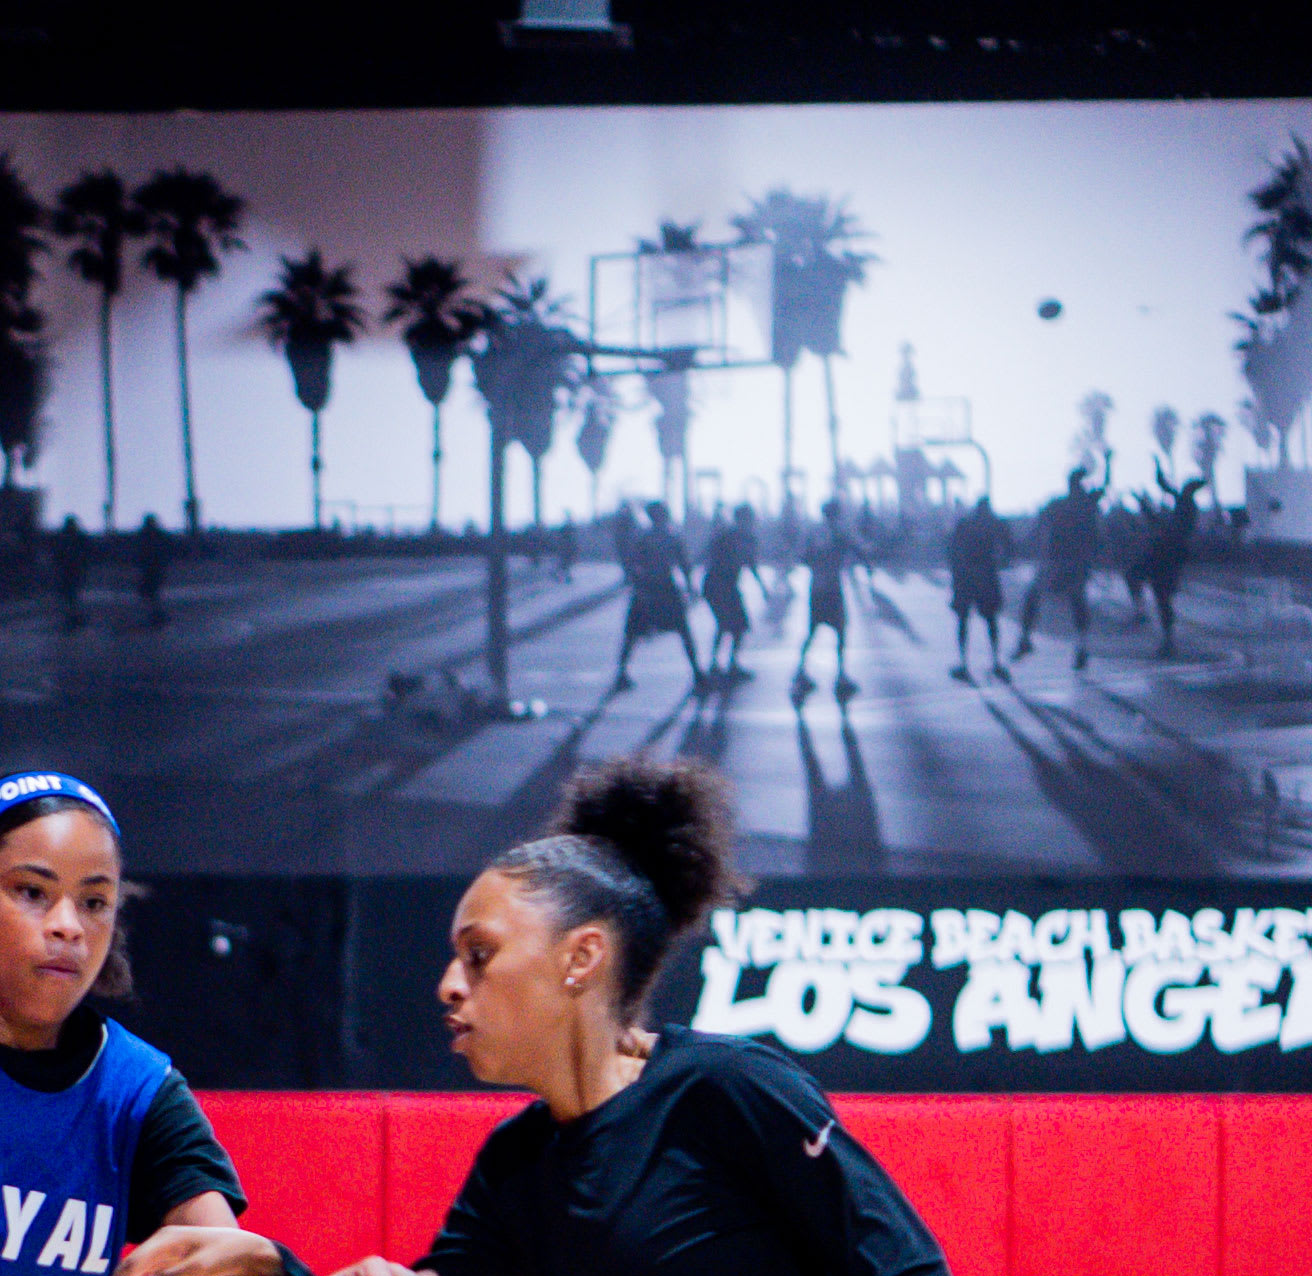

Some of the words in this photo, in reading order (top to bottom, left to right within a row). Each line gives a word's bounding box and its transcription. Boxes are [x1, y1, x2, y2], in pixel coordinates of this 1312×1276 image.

[711, 907, 924, 966] VENICE
[931, 907, 1116, 968] BEACH
[1118, 907, 1312, 967] BASKE
[690, 946, 933, 1055] LOS
